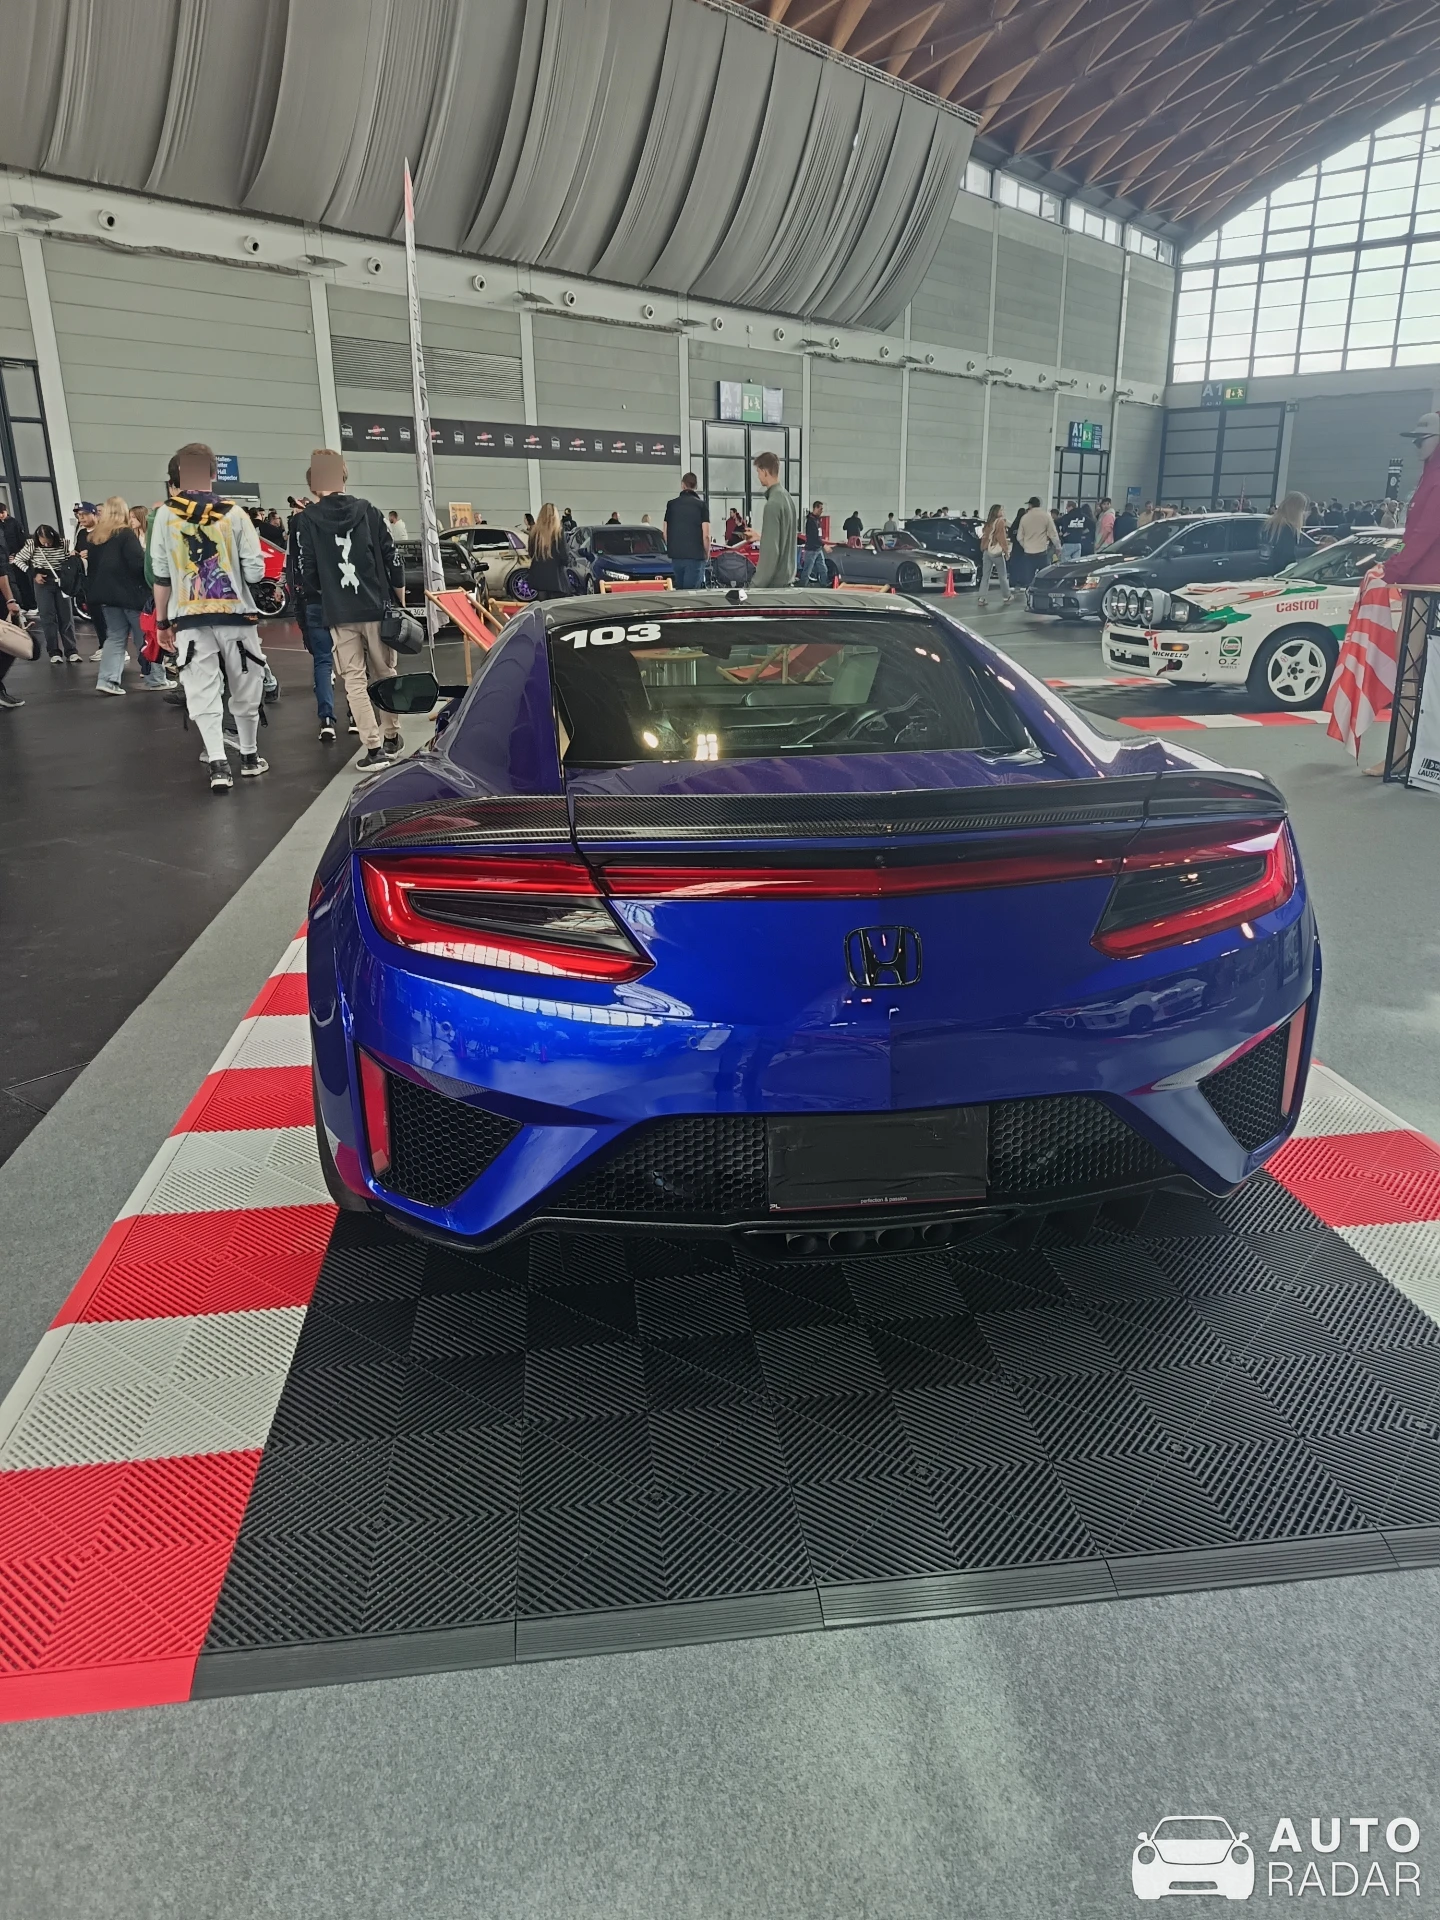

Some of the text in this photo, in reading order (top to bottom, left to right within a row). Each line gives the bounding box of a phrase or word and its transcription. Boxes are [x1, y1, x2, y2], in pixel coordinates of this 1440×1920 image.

[1202, 383, 1223, 397] A1
[1072, 422, 1083, 437] A1
[1276, 599, 1319, 613] Castrol
[560, 623, 661, 649] 103
[1152, 651, 1189, 659] MICHELIN
[1418, 769, 1440, 780] LAUSIT
